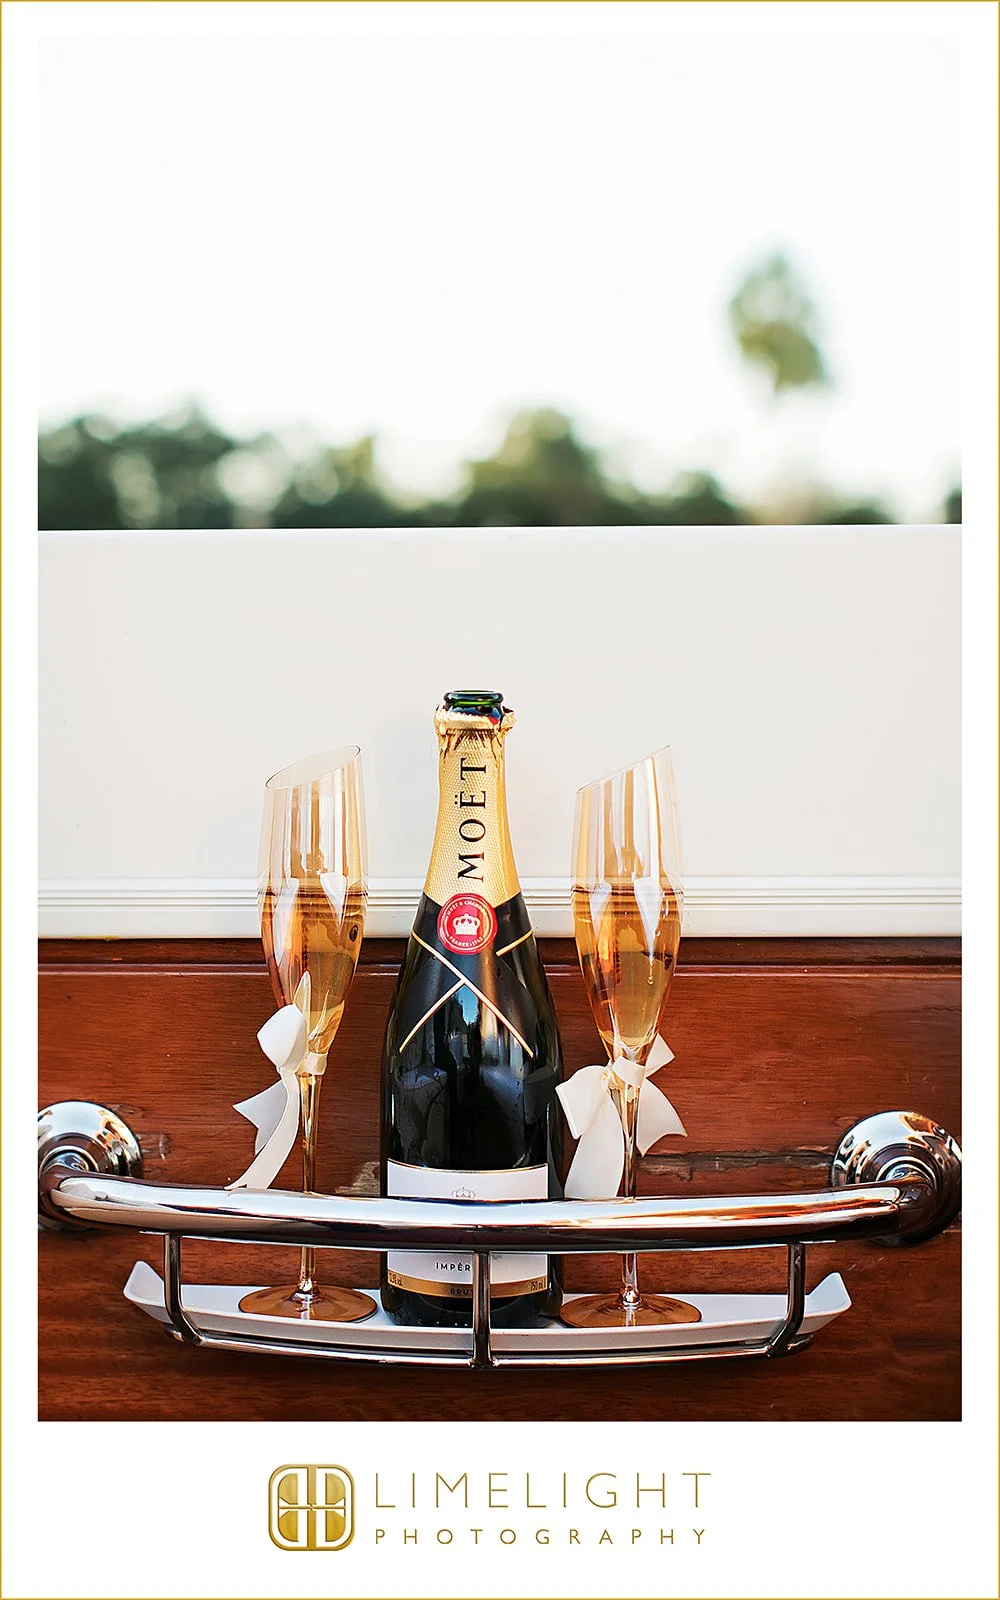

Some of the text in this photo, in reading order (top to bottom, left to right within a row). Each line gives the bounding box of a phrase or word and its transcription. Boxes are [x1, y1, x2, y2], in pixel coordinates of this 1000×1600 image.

[454, 758, 487, 882] MOËT
[449, 935, 470, 947] FRANCE
[435, 1262, 471, 1272] IMPÉR
